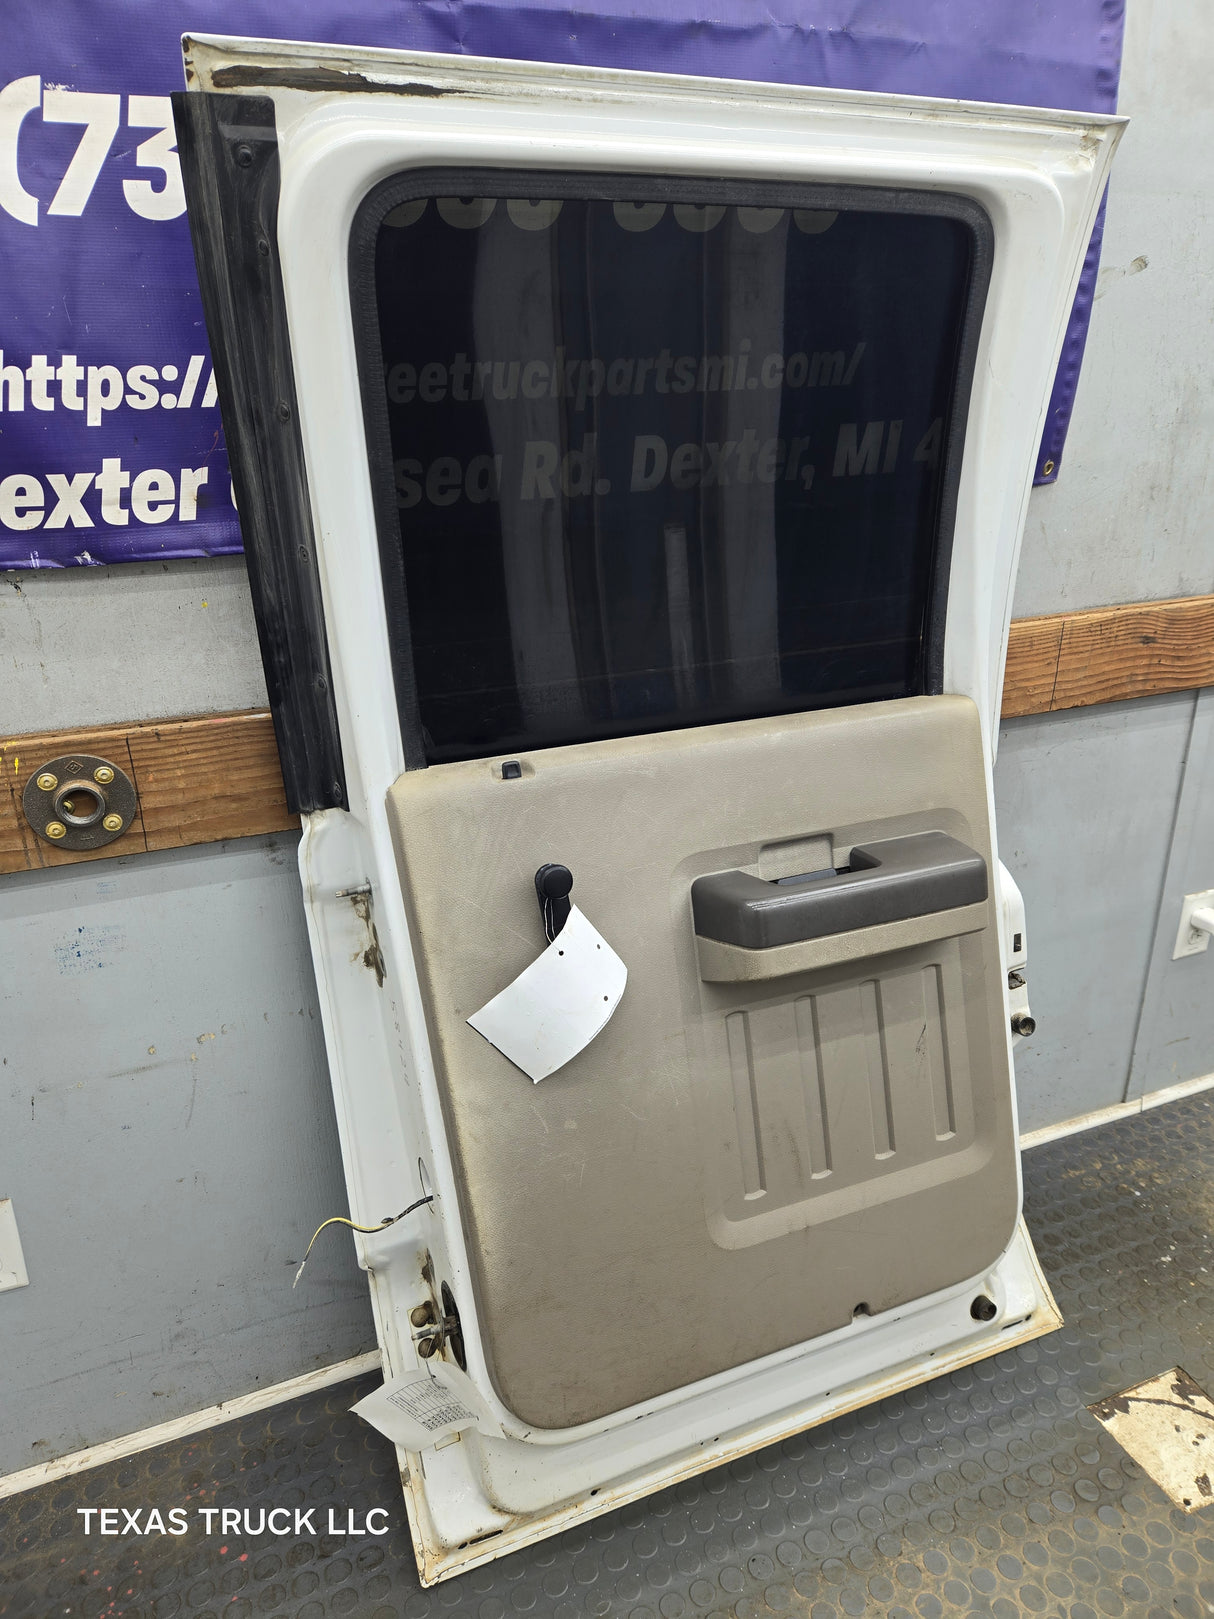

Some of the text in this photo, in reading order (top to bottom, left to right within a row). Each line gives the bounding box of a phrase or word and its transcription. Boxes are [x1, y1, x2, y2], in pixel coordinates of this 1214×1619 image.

[384, 338, 868, 411] eetruckpartsmi.com/
[0, 457, 208, 531] exter
[519, 431, 611, 501] Rd.
[630, 428, 816, 492] Dexter,
[832, 419, 904, 477] MI
